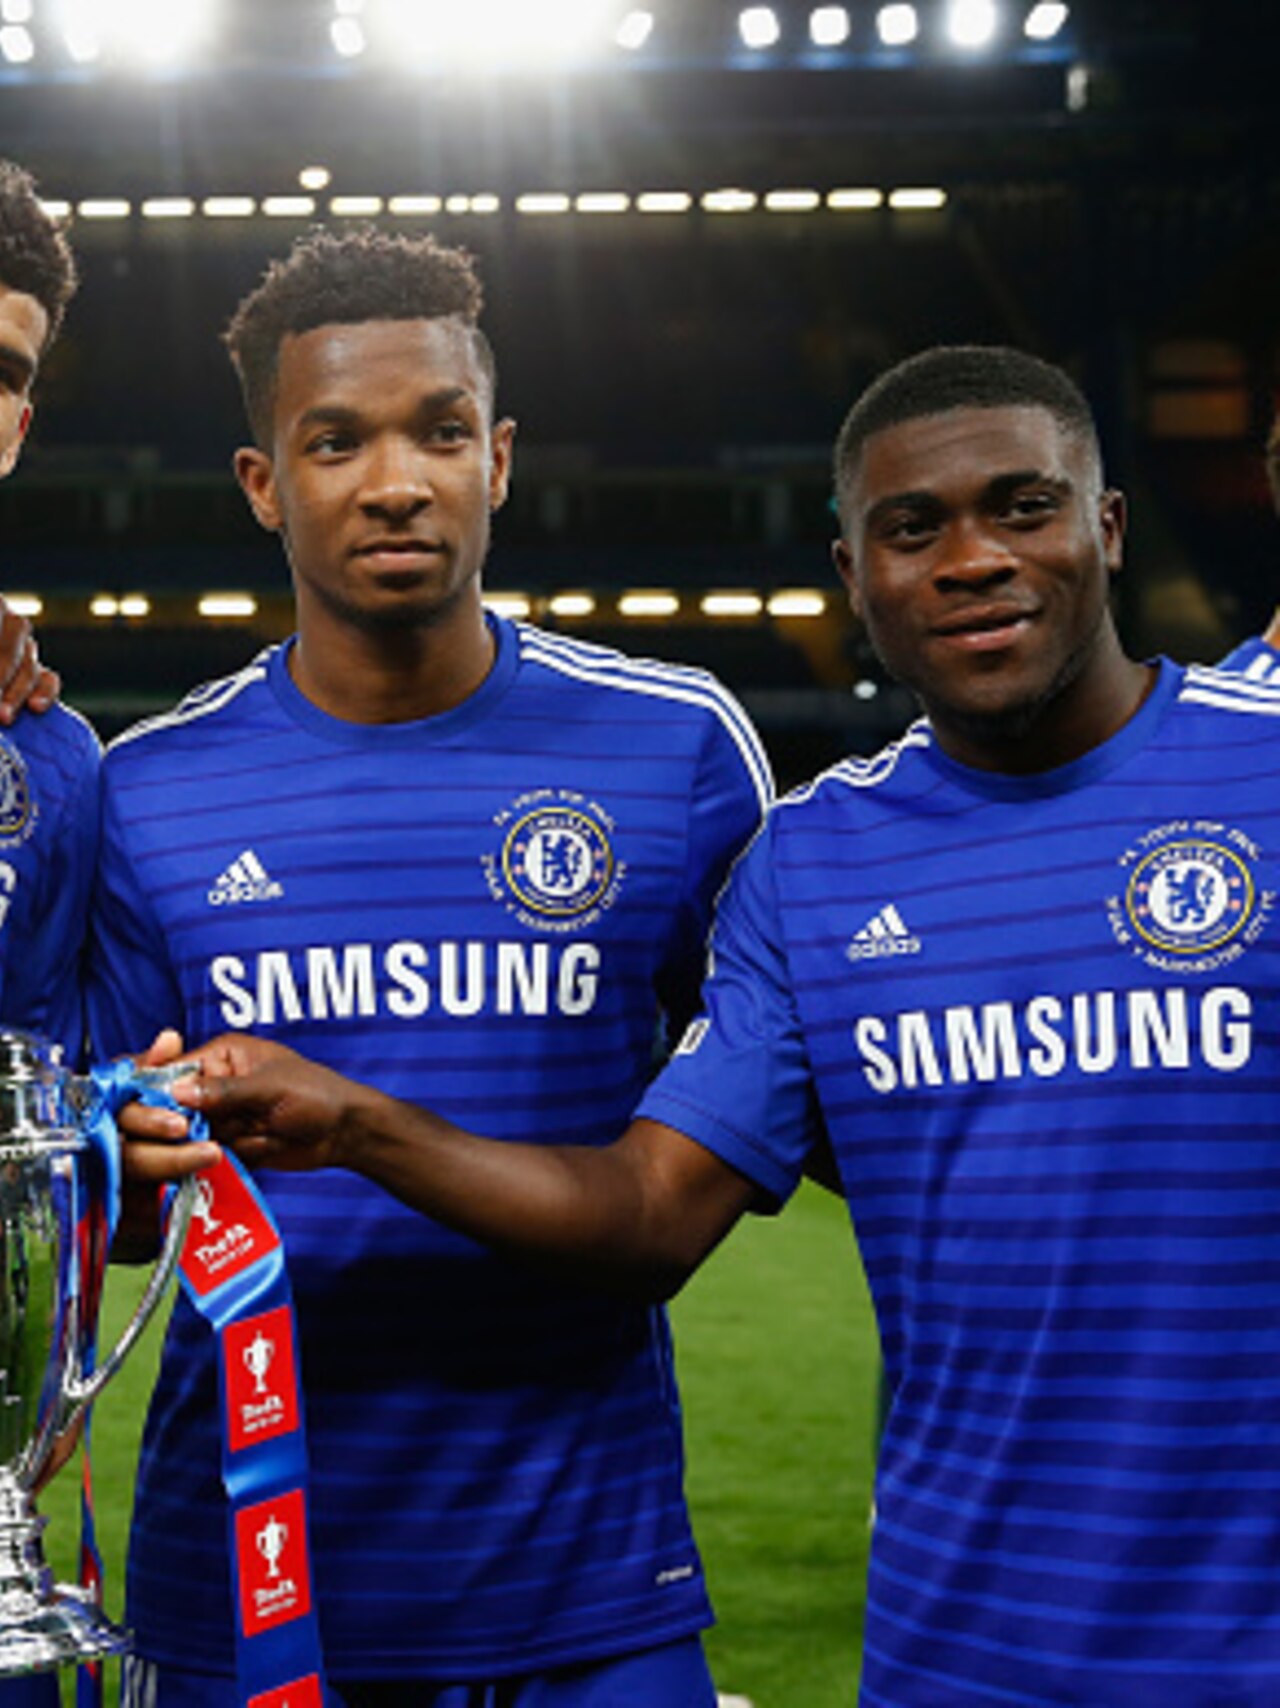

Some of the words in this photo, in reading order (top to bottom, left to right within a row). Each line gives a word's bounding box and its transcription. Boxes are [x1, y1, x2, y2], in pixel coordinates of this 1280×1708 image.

[207, 879, 284, 906] adidas
[845, 935, 922, 963] adidas
[210, 941, 602, 1029] SAMSUNG
[855, 987, 1253, 1093] SAMSUNG
